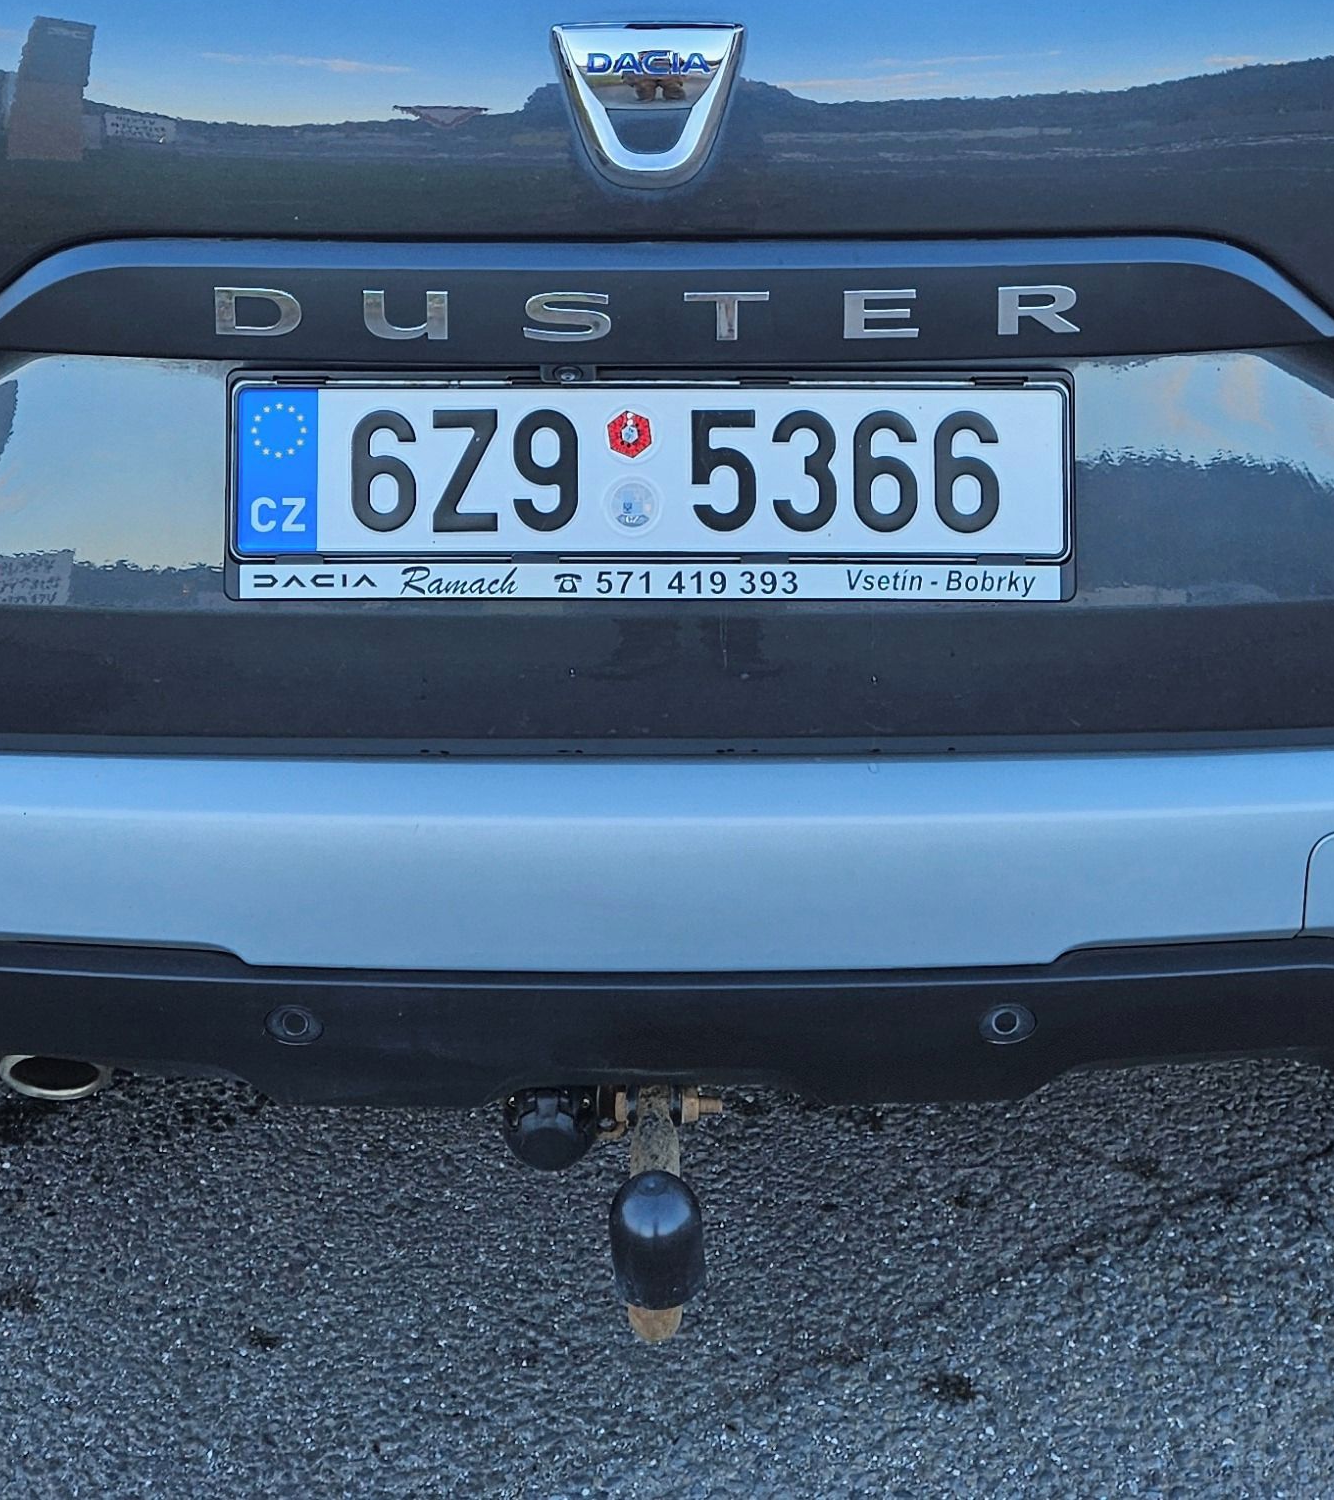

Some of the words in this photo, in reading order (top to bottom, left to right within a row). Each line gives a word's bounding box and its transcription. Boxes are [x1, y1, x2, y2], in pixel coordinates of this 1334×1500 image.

[586, 50, 711, 75] DACIA
[214, 284, 1081, 342] DUSTER
[349, 408, 580, 534] 6Z9
[690, 408, 1000, 534] 5366
[250, 496, 307, 533] CZ
[252, 573, 378, 588] DACIA
[399, 566, 518, 596] Ramach
[595, 571, 653, 595] 571
[666, 571, 728, 595] 419
[738, 571, 800, 595] 393
[845, 568, 924, 592] Vsetín
[945, 569, 1037, 598] Bobrky
